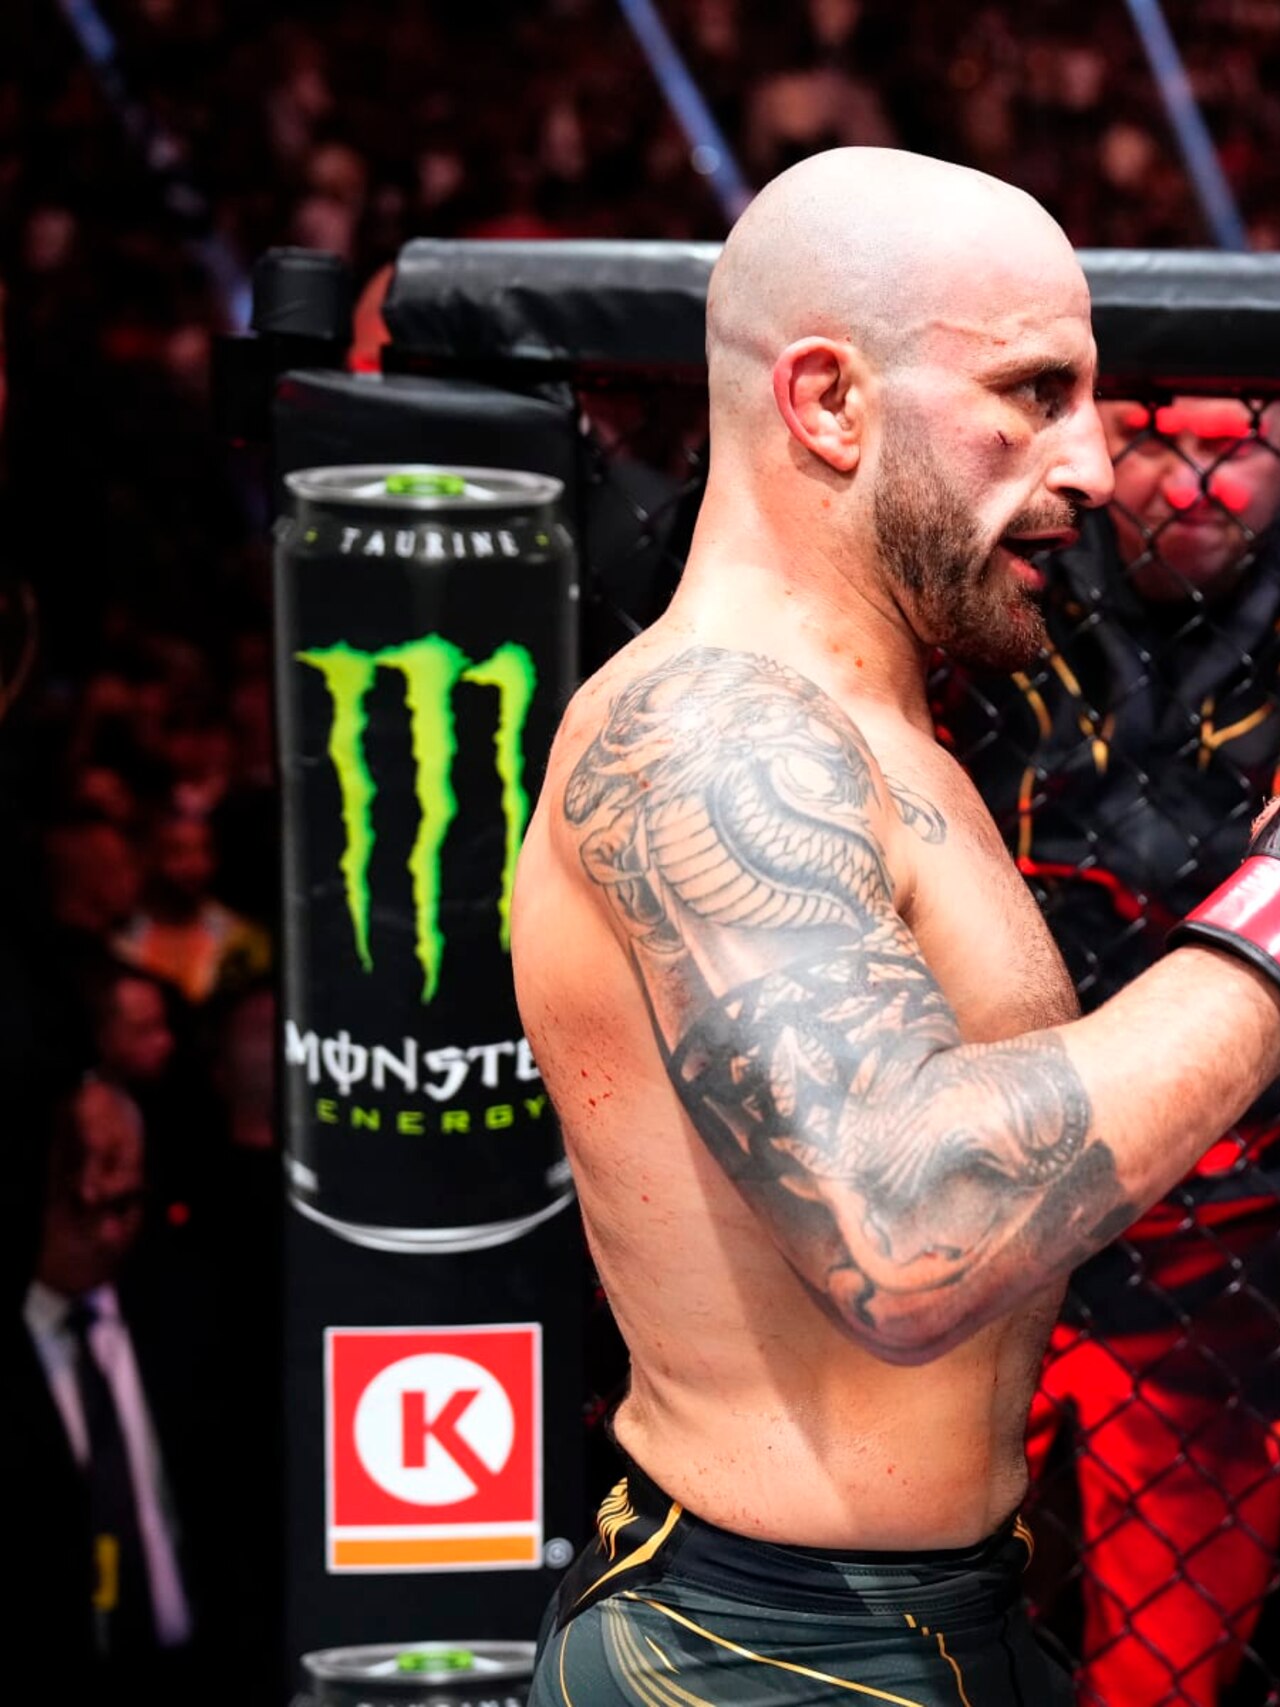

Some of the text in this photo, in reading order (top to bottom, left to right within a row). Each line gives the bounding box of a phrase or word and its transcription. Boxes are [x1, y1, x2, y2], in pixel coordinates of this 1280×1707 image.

[340, 526, 520, 559] TAURINE
[285, 1019, 541, 1101] MONSTE
[316, 1095, 547, 1135] ENERGY
[401, 1388, 499, 1492] K
